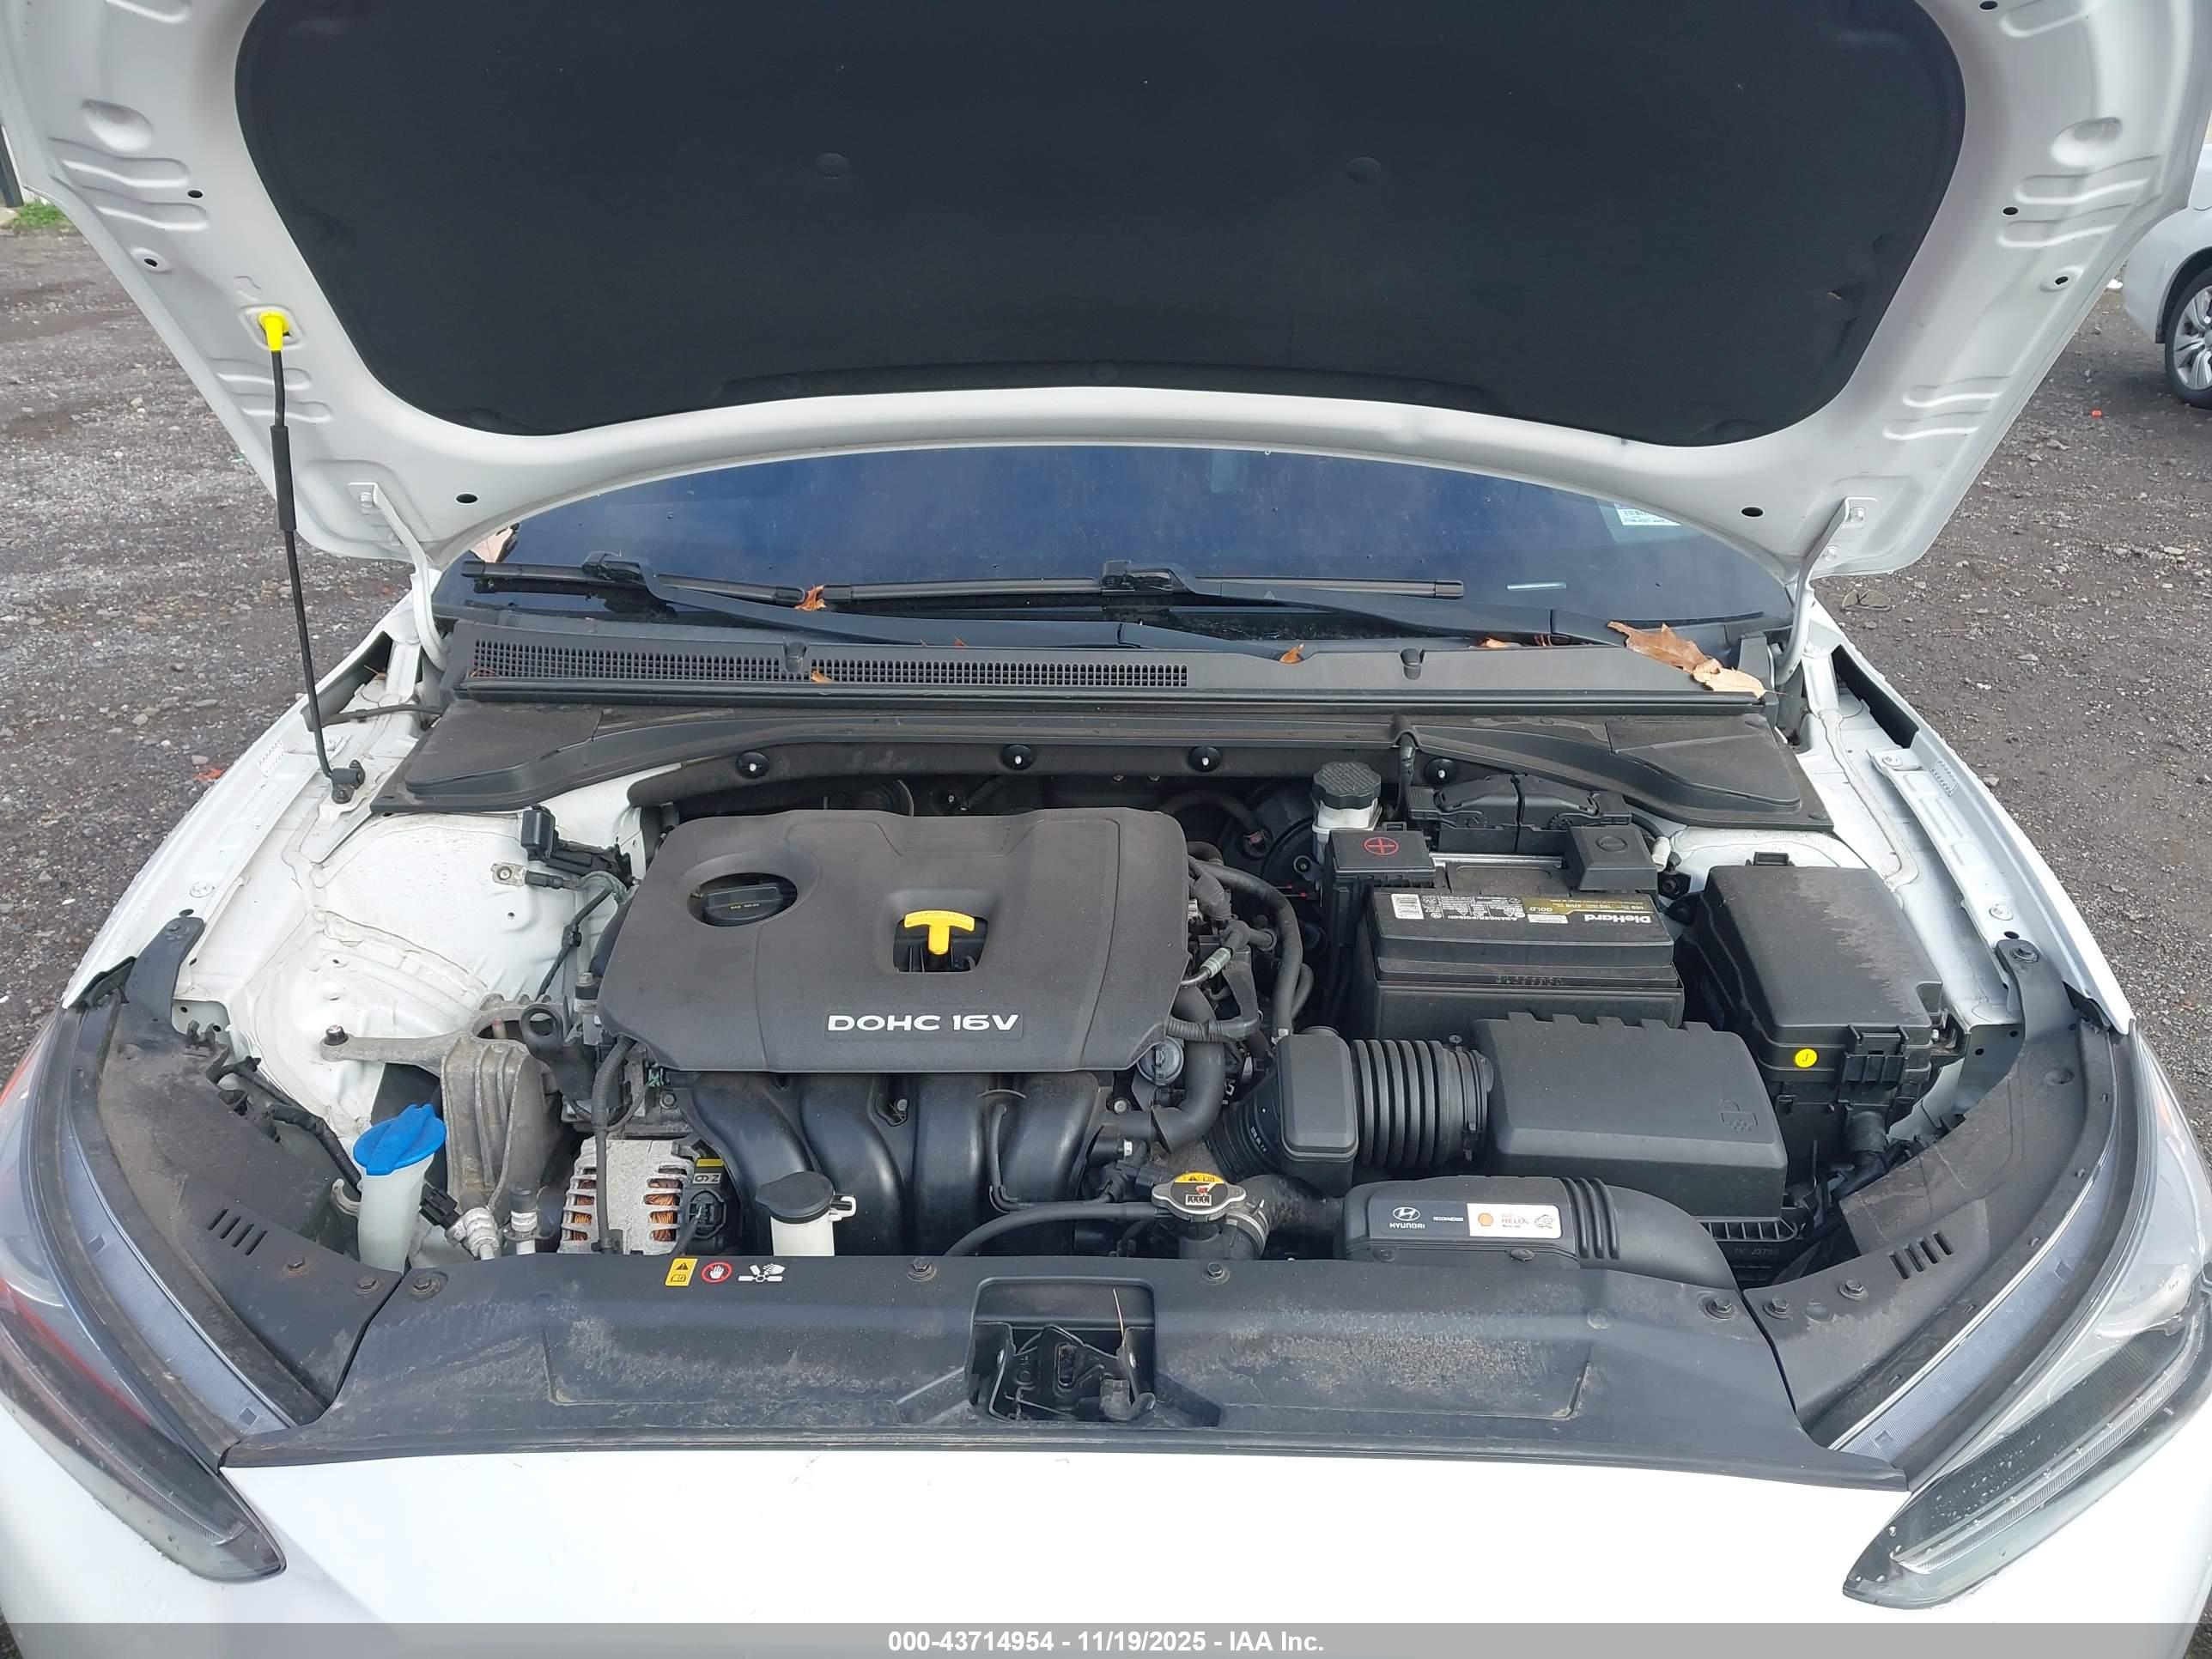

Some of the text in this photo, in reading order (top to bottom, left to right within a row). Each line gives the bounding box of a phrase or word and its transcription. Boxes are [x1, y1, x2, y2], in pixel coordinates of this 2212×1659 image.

[1584, 913, 1651, 924] DieHard
[829, 1015, 1018, 1030] DOHC 16V
